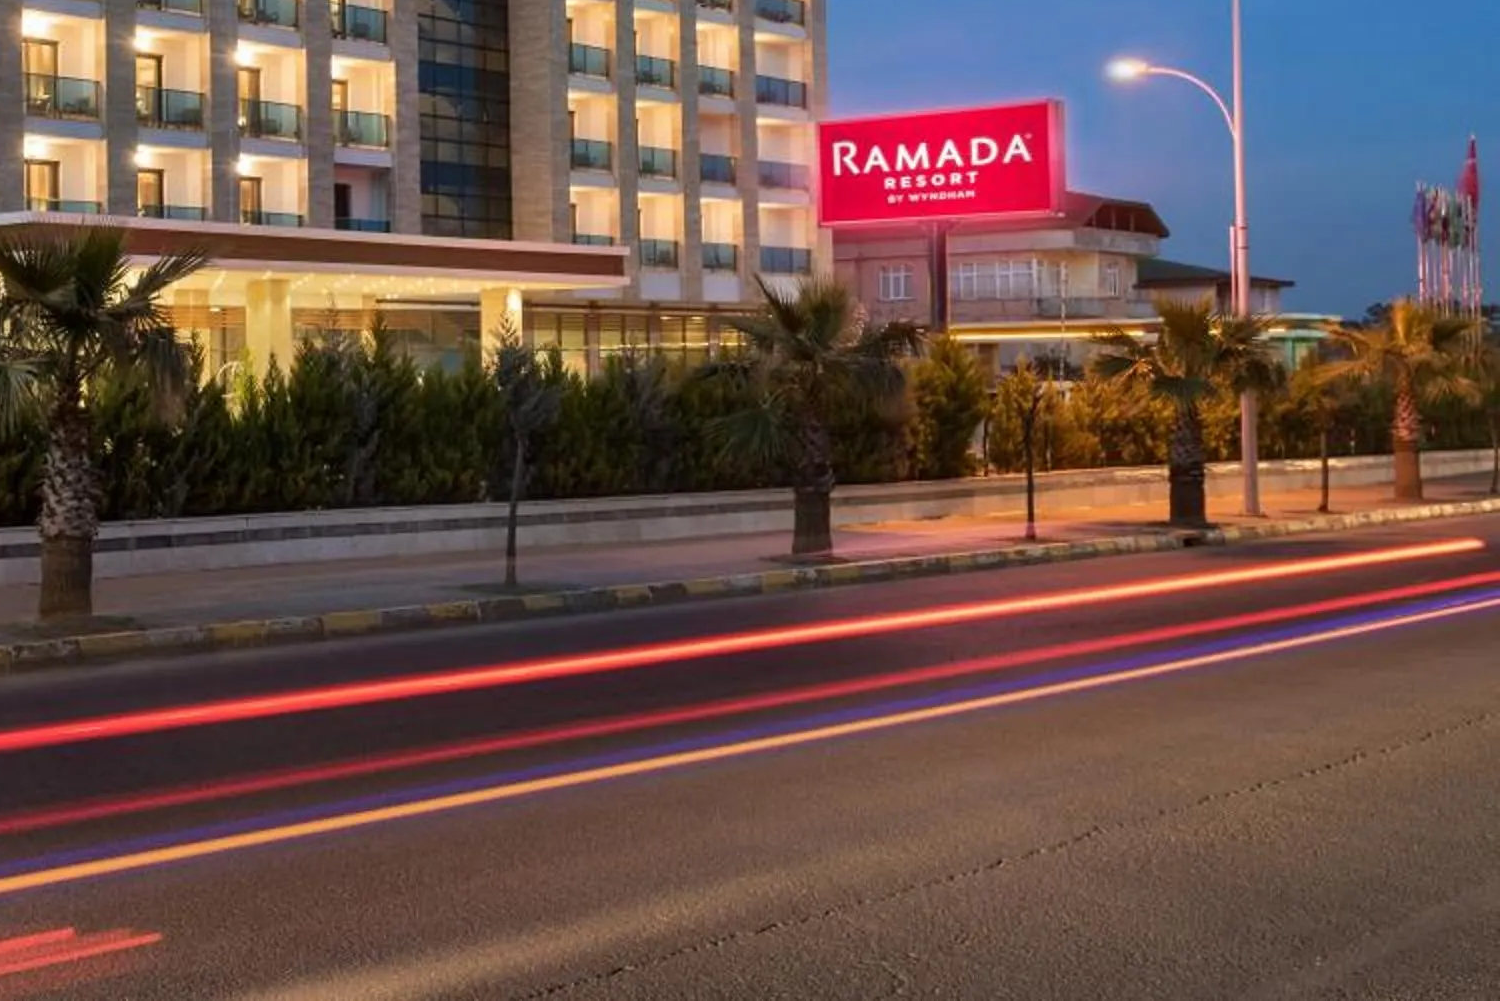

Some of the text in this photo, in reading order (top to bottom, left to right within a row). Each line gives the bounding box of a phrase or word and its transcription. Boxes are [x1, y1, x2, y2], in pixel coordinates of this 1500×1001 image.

[832, 134, 1032, 176] RAMADA
[884, 171, 979, 189] RESORT
[888, 190, 976, 204] BY WYNDHAM
